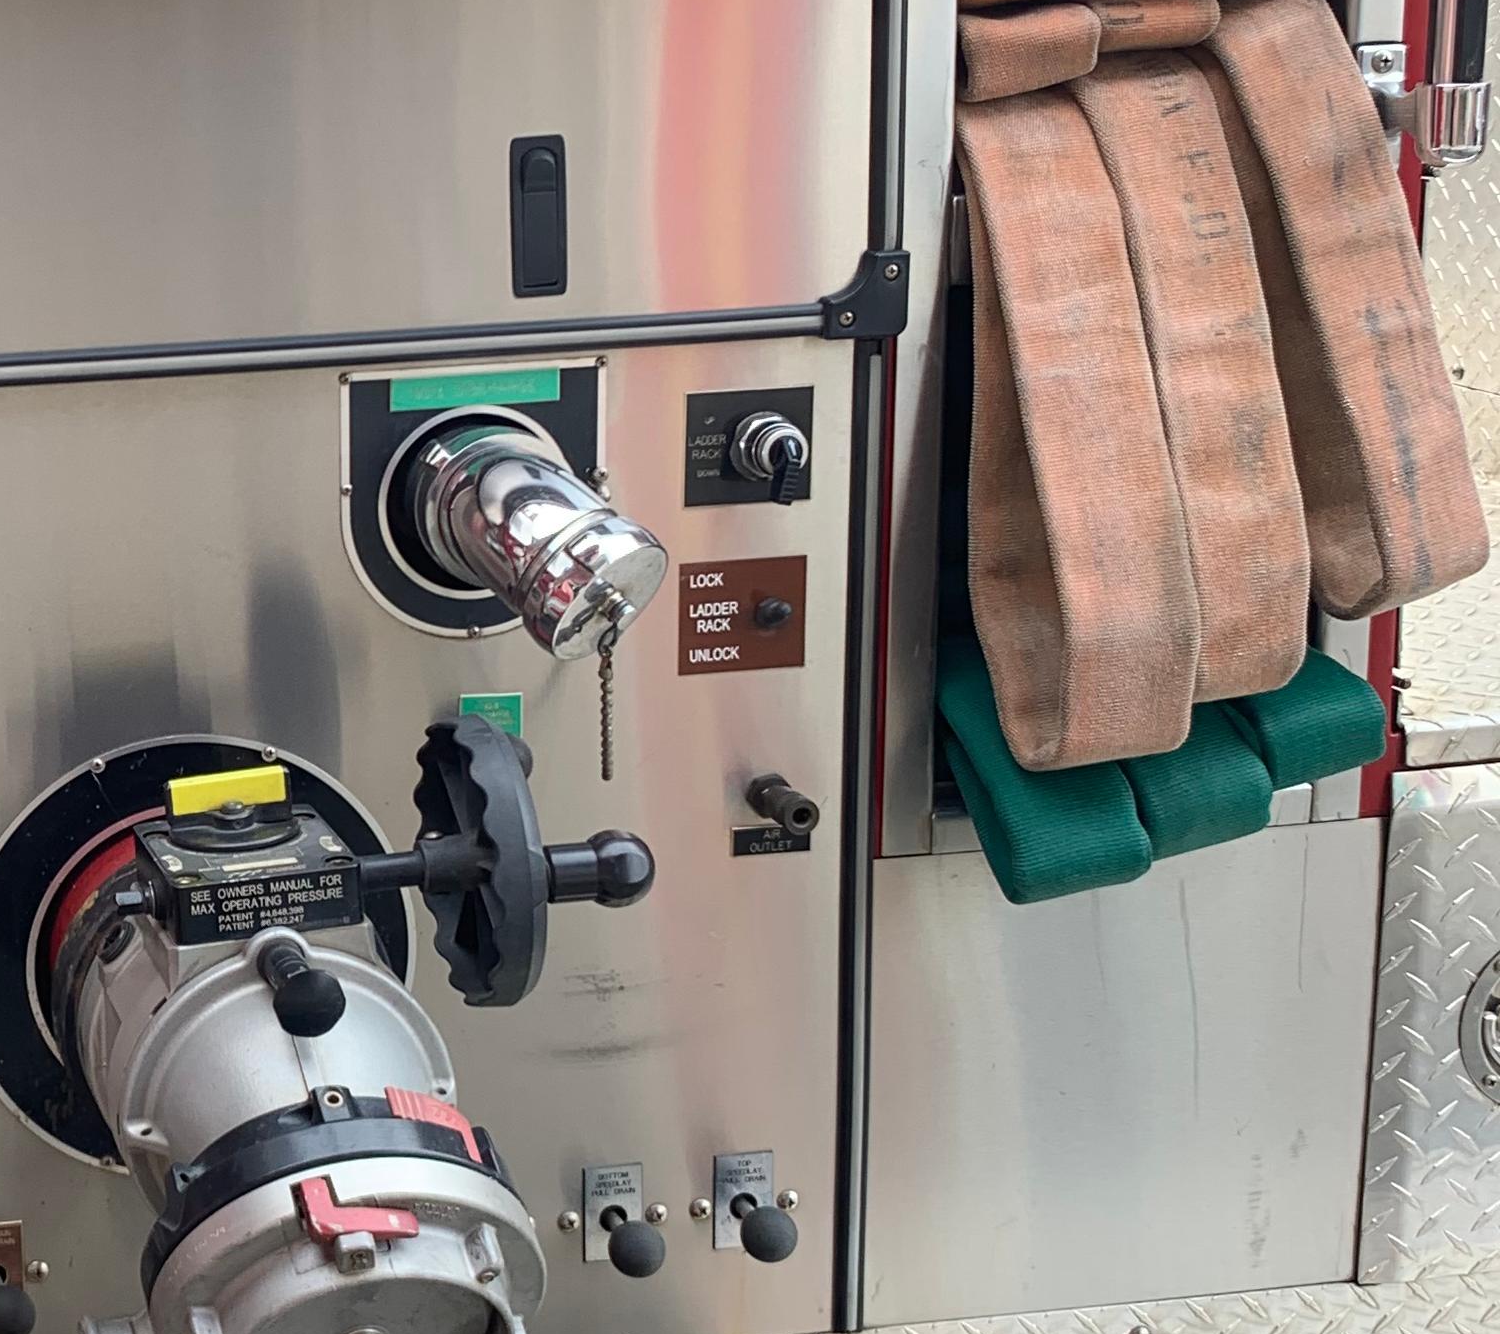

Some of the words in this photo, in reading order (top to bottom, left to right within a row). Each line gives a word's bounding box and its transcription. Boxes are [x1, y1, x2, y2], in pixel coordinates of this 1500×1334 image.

[688, 433, 727, 446] LADDER
[692, 448, 721, 460] RACK
[697, 469, 721, 478] DOWN
[689, 573, 724, 589] LOCK
[689, 600, 739, 617] LADDER
[696, 618, 731, 633] RACK
[689, 646, 740, 663] UNLOCK
[749, 840, 793, 853] OUTLET
[190, 890, 212, 903] SEE
[217, 881, 264, 900] OWNERS
[270, 876, 314, 893] MANUAL
[320, 874, 342, 887] FOR
[190, 903, 215, 916] MAX
[222, 894, 282, 913] OPERATING
[288, 887, 344, 904] PRESSURE
[218, 912, 254, 924] PATENT
[219, 920, 254, 932] PATENT
[595, 1179, 632, 1189] SPEEDLAY
